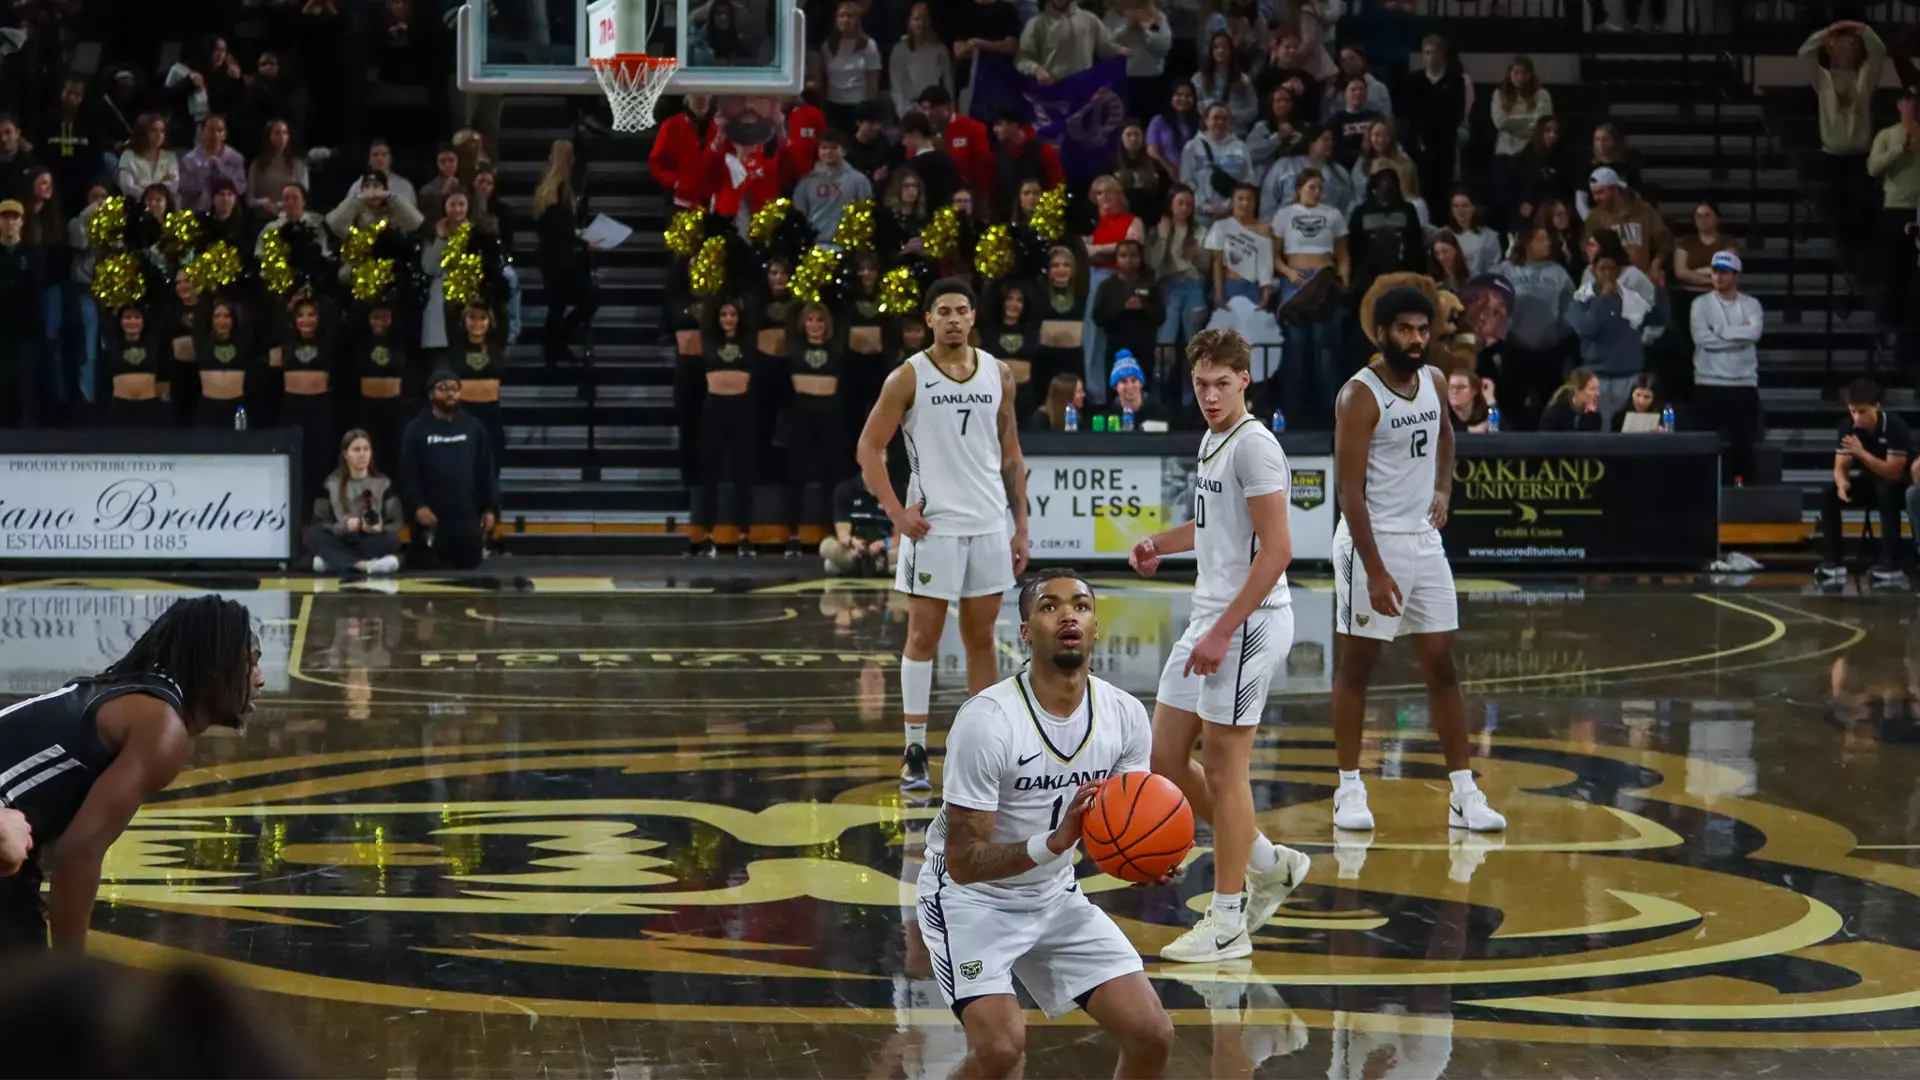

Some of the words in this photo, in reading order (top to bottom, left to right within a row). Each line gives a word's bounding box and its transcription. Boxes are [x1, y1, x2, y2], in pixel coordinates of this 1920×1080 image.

[931, 394, 993, 405] OAKLAND
[957, 409, 971, 436] 7
[1391, 410, 1438, 429] OAKLAND
[1411, 429, 1428, 458] 12
[9, 460, 68, 472] PROUDLY
[71, 460, 156, 472] DISTRIBUTED
[1453, 458, 1605, 482] OAKLAND
[1054, 469, 1139, 490] MORE.
[1292, 476, 1321, 486] ARMY
[1465, 482, 1588, 500] UNIVERSITY
[0, 500, 77, 530] ano
[94, 478, 287, 531] Brothers
[1072, 496, 1156, 517] LESS.
[6, 533, 135, 550] ESTABLISHED
[144, 533, 188, 550] 1885
[1495, 527, 1528, 538] Credit
[1531, 527, 1563, 538] Union
[1468, 546, 1586, 558] www.oucreditunion.org
[1014, 769, 1108, 791] OAKLAND
[1050, 795, 1063, 831] 1
